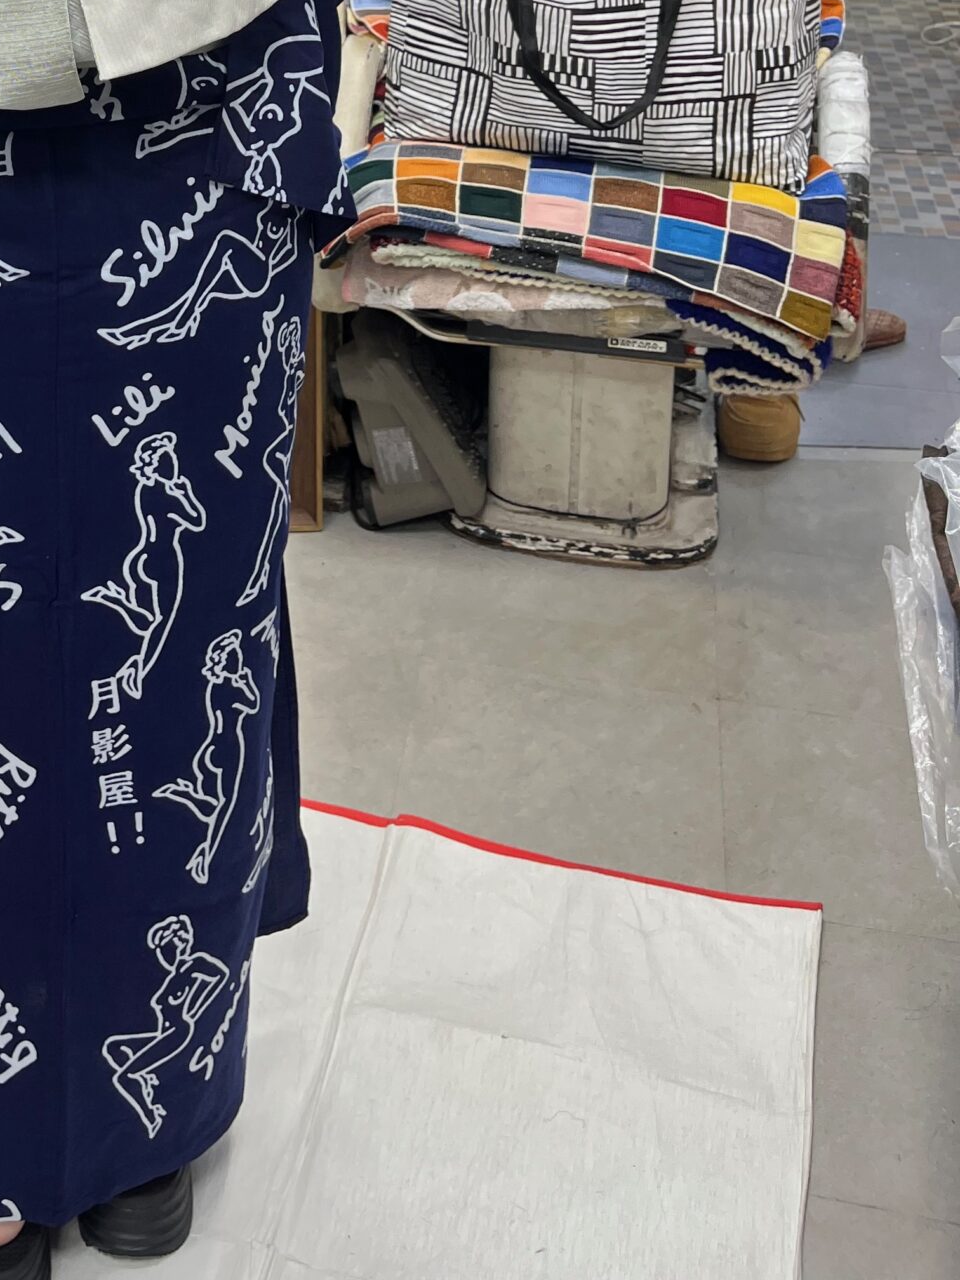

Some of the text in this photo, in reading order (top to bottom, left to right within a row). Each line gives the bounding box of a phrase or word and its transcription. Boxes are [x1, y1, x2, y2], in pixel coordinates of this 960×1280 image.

[91, 372, 176, 448] Lili
[213, 293, 286, 480] Monica
[189, 955, 251, 1082] Sonia
